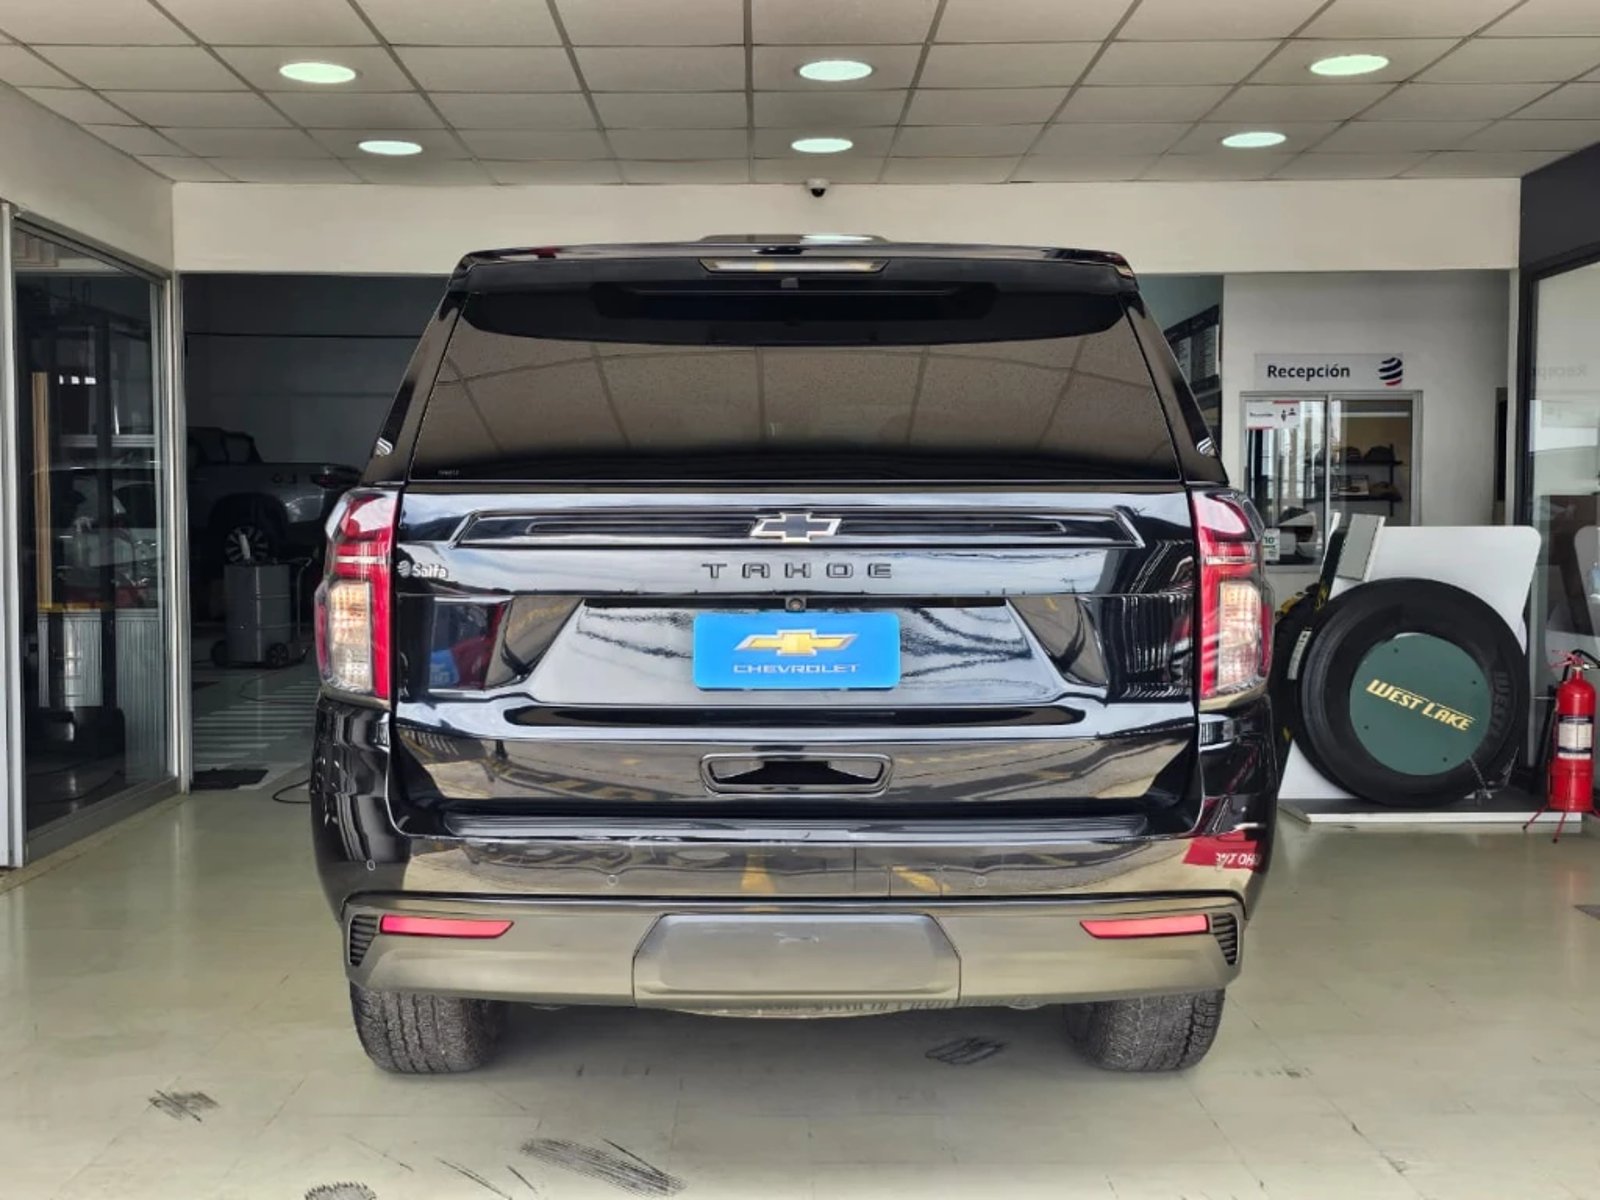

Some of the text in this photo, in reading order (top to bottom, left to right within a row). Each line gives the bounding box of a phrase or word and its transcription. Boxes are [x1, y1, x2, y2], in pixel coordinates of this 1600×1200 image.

[1267, 363, 1350, 382] Recepción
[412, 561, 449, 578] Salfa
[701, 562, 893, 579] TAHOE
[1366, 679, 1475, 731] WEST LAKE
